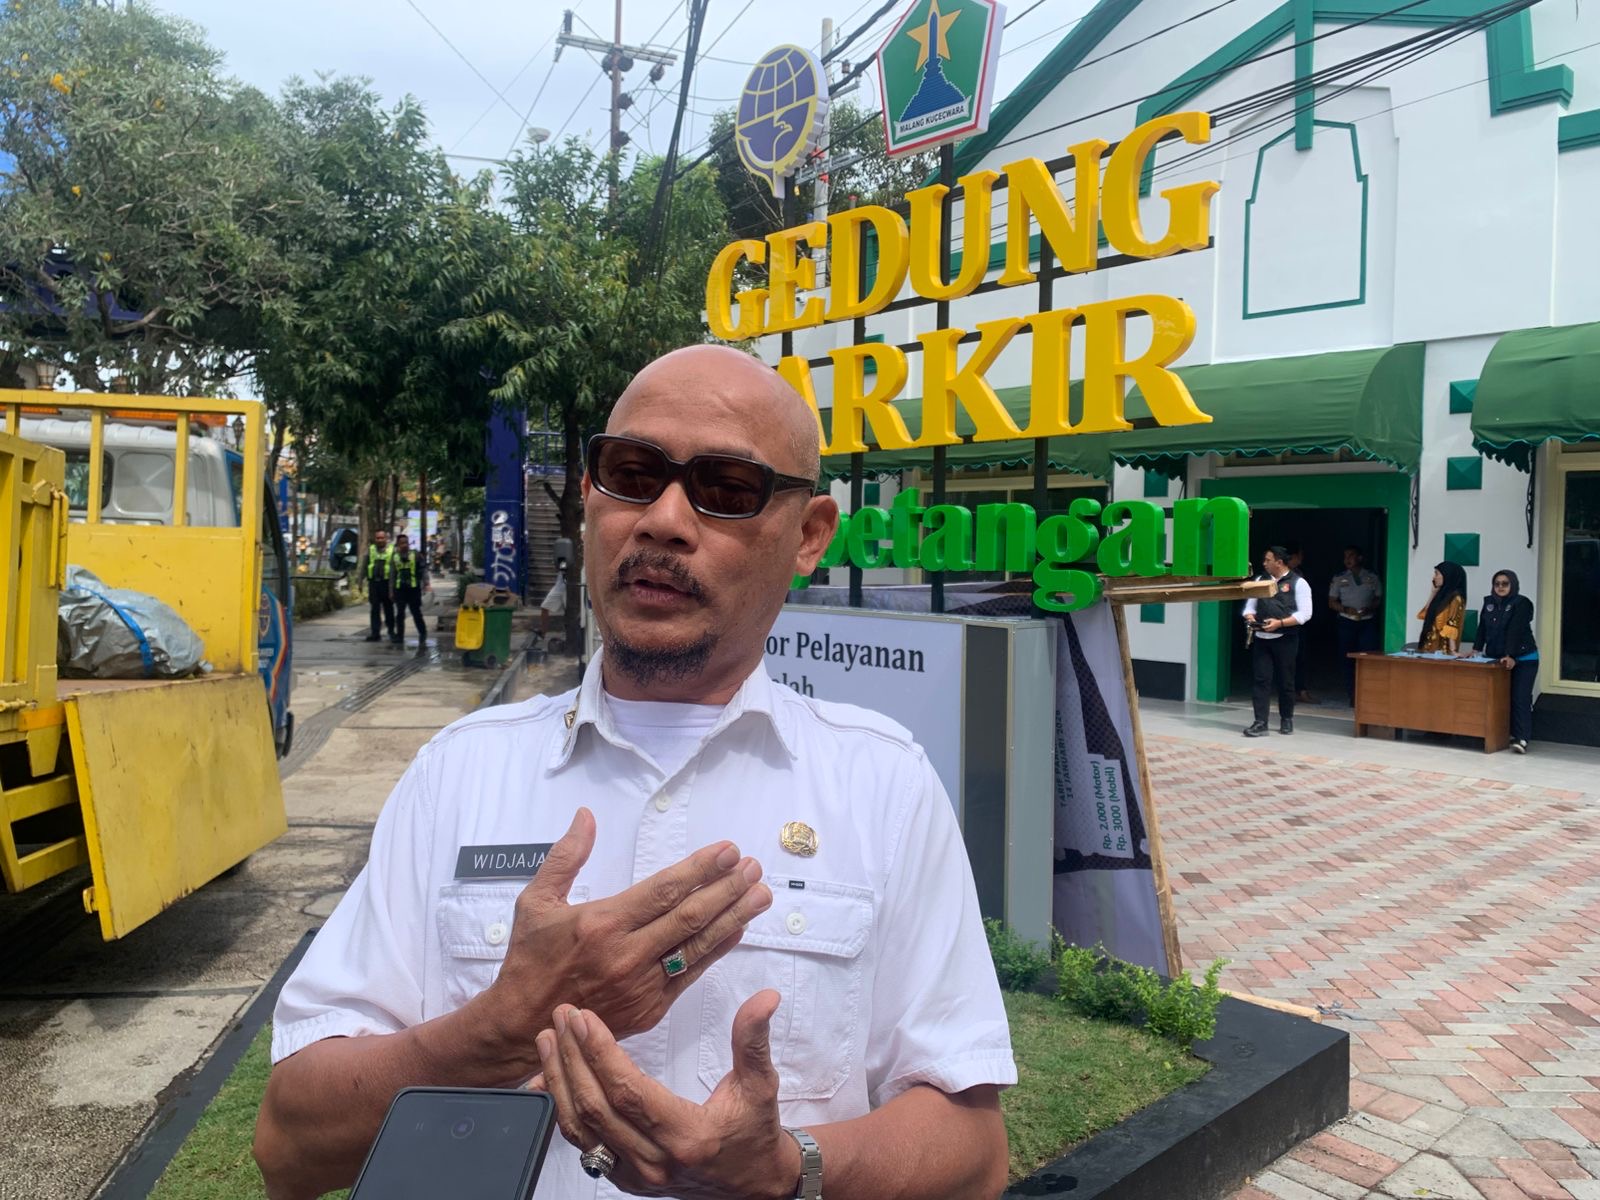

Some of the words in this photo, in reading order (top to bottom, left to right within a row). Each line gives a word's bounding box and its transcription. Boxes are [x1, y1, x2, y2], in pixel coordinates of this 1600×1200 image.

[706, 111, 1221, 341] GEDUNG
[796, 631, 926, 673] Pelayanan
[1058, 738, 1072, 784] JANUARI
[1090, 760, 1105, 800] (Motor)
[1104, 766, 1121, 802] (Mobil)
[1097, 802, 1109, 831] 2.000
[1111, 805, 1124, 832] 3000
[1103, 832, 1113, 850] Rp.
[1116, 834, 1127, 851] Rp.
[473, 852, 545, 869] WIDJAJA
